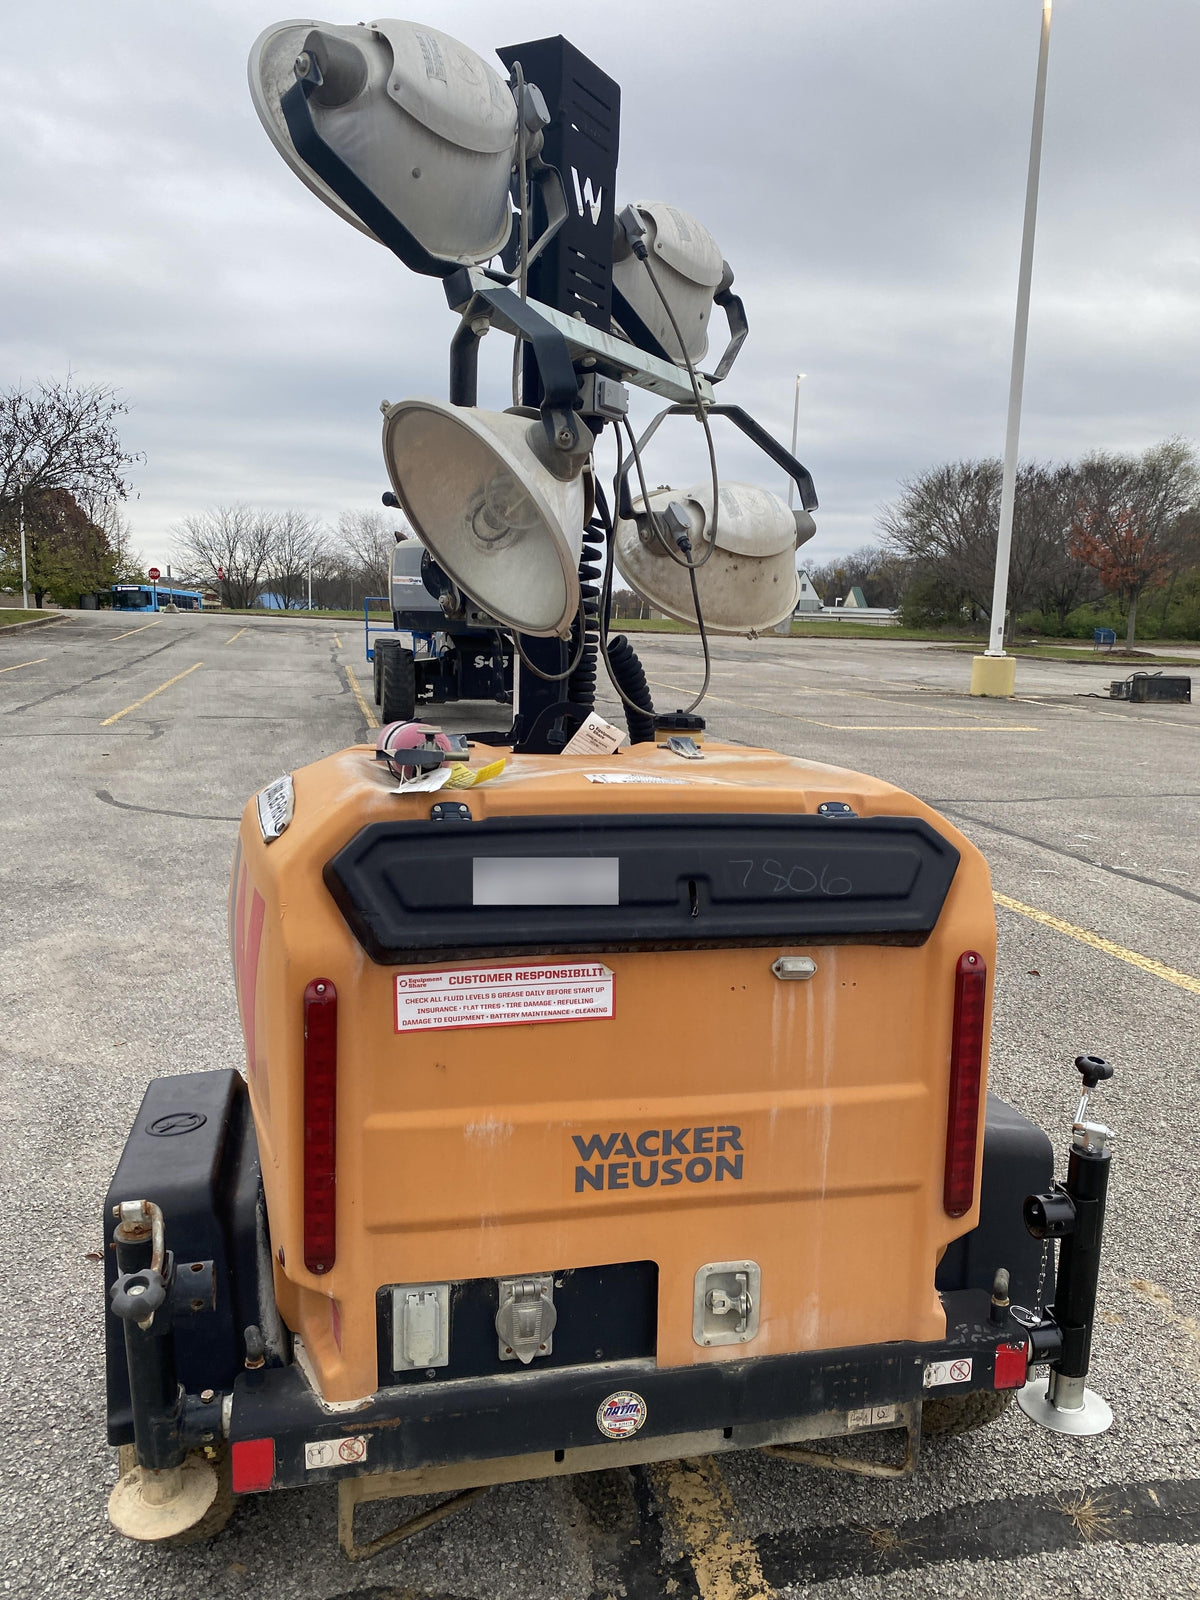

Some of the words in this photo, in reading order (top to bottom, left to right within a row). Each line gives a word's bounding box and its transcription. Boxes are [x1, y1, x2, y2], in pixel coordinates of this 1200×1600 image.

[728, 858, 853, 895] 7806
[449, 972, 512, 985] CUSTOMER
[516, 968, 604, 980] RESPONSIBILIT
[402, 1018, 431, 1026] DAMAGE
[521, 1009, 569, 1017] MAINTENANCE
[418, 1006, 457, 1014] INSURANCE
[571, 1125, 744, 1161] WACKER
[574, 1154, 744, 1192] NEUSON
